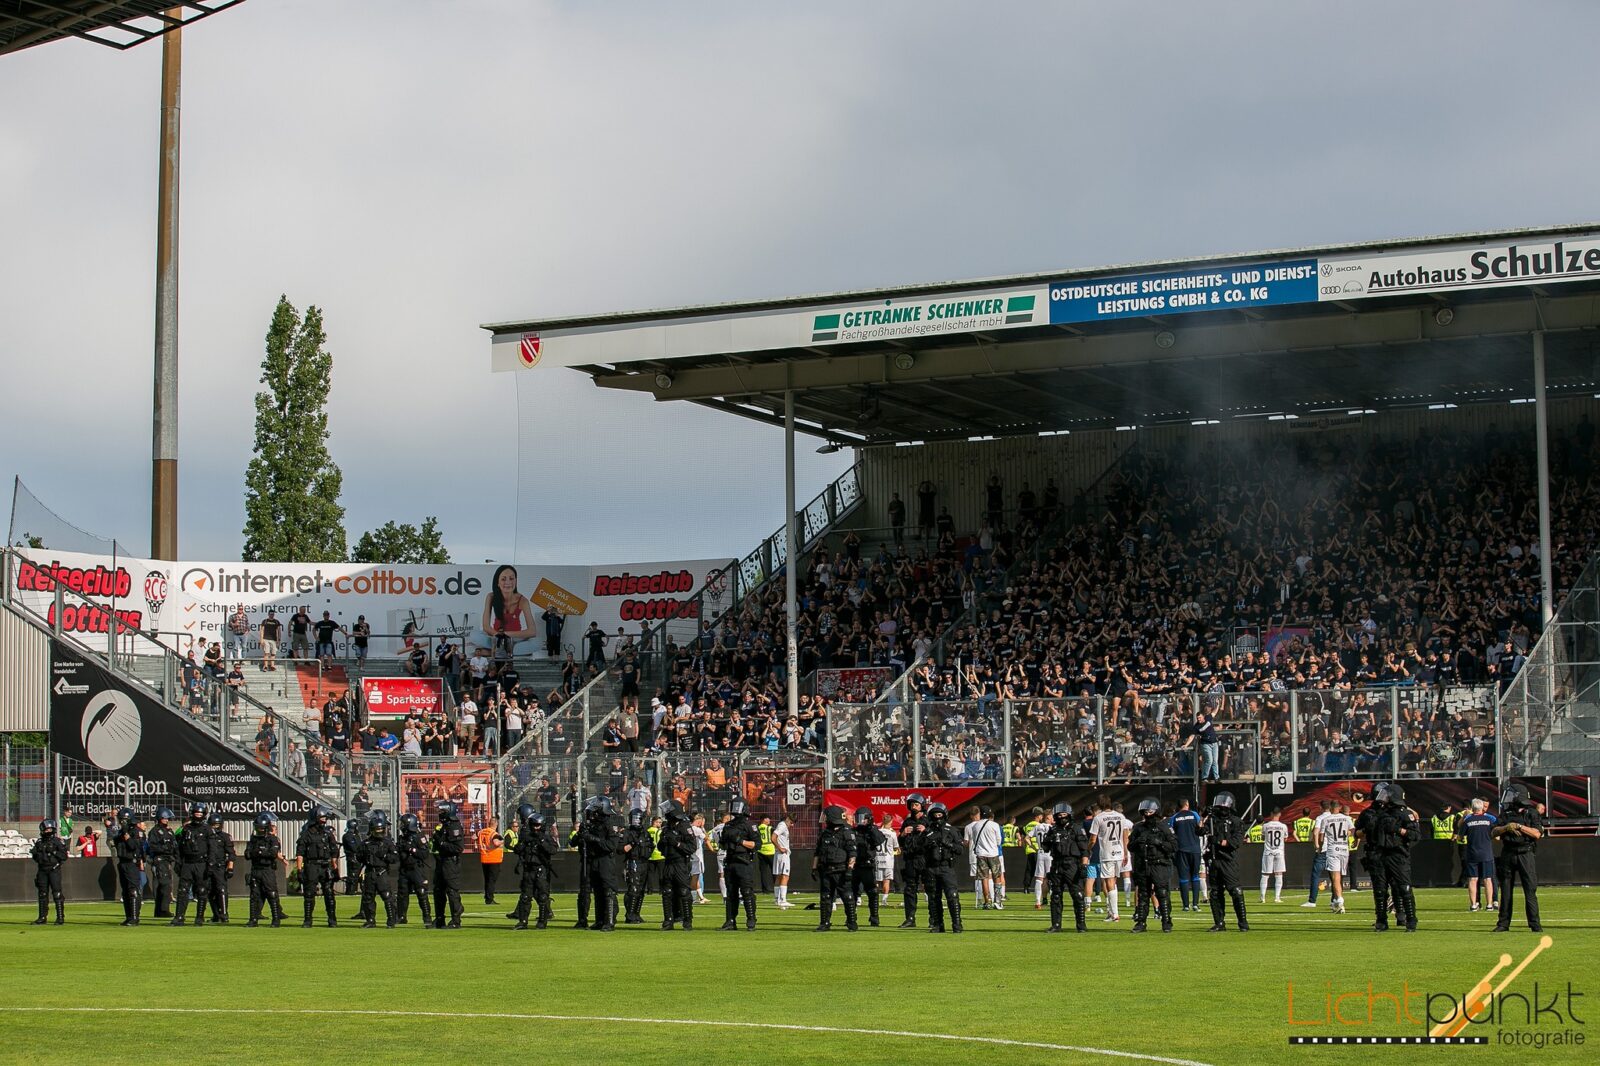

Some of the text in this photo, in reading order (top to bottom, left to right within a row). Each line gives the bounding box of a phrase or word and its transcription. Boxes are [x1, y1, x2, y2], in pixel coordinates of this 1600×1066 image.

[1369, 242, 1600, 288] Autohaus Schulze
[1051, 265, 1317, 301] OSTDEUTSCHE SICHERHEITS- UND DIENST-
[927, 298, 1004, 320] SCHENKER
[1097, 286, 1268, 314] LEISTUNGS GMBH & CO. KG
[840, 316, 1003, 340] Fachgroßhandelsgesellschaft mbH
[17, 560, 132, 598] Reiseclub
[218, 567, 482, 596] internet-cottbus.de
[593, 570, 693, 597] Reiseclub
[386, 694, 438, 705] Sparkasse
[183, 763, 246, 772] WaschSalon Cottbus
[59, 775, 168, 796] WaschSalon
[183, 775, 193, 783] Am
[194, 775, 209, 783] Gleis
[209, 775, 214, 783] 5
[217, 775, 236, 783] 03042
[236, 774, 261, 783] Cottbus
[1278, 776, 1287, 790] 9
[183, 786, 250, 795] Tel. (0355) 756 266 251
[474, 787, 482, 800] 7
[793, 788, 800, 801] 8
[1107, 821, 1122, 841] 21
[1267, 830, 1281, 847] 18
[1330, 822, 1347, 841] 14
